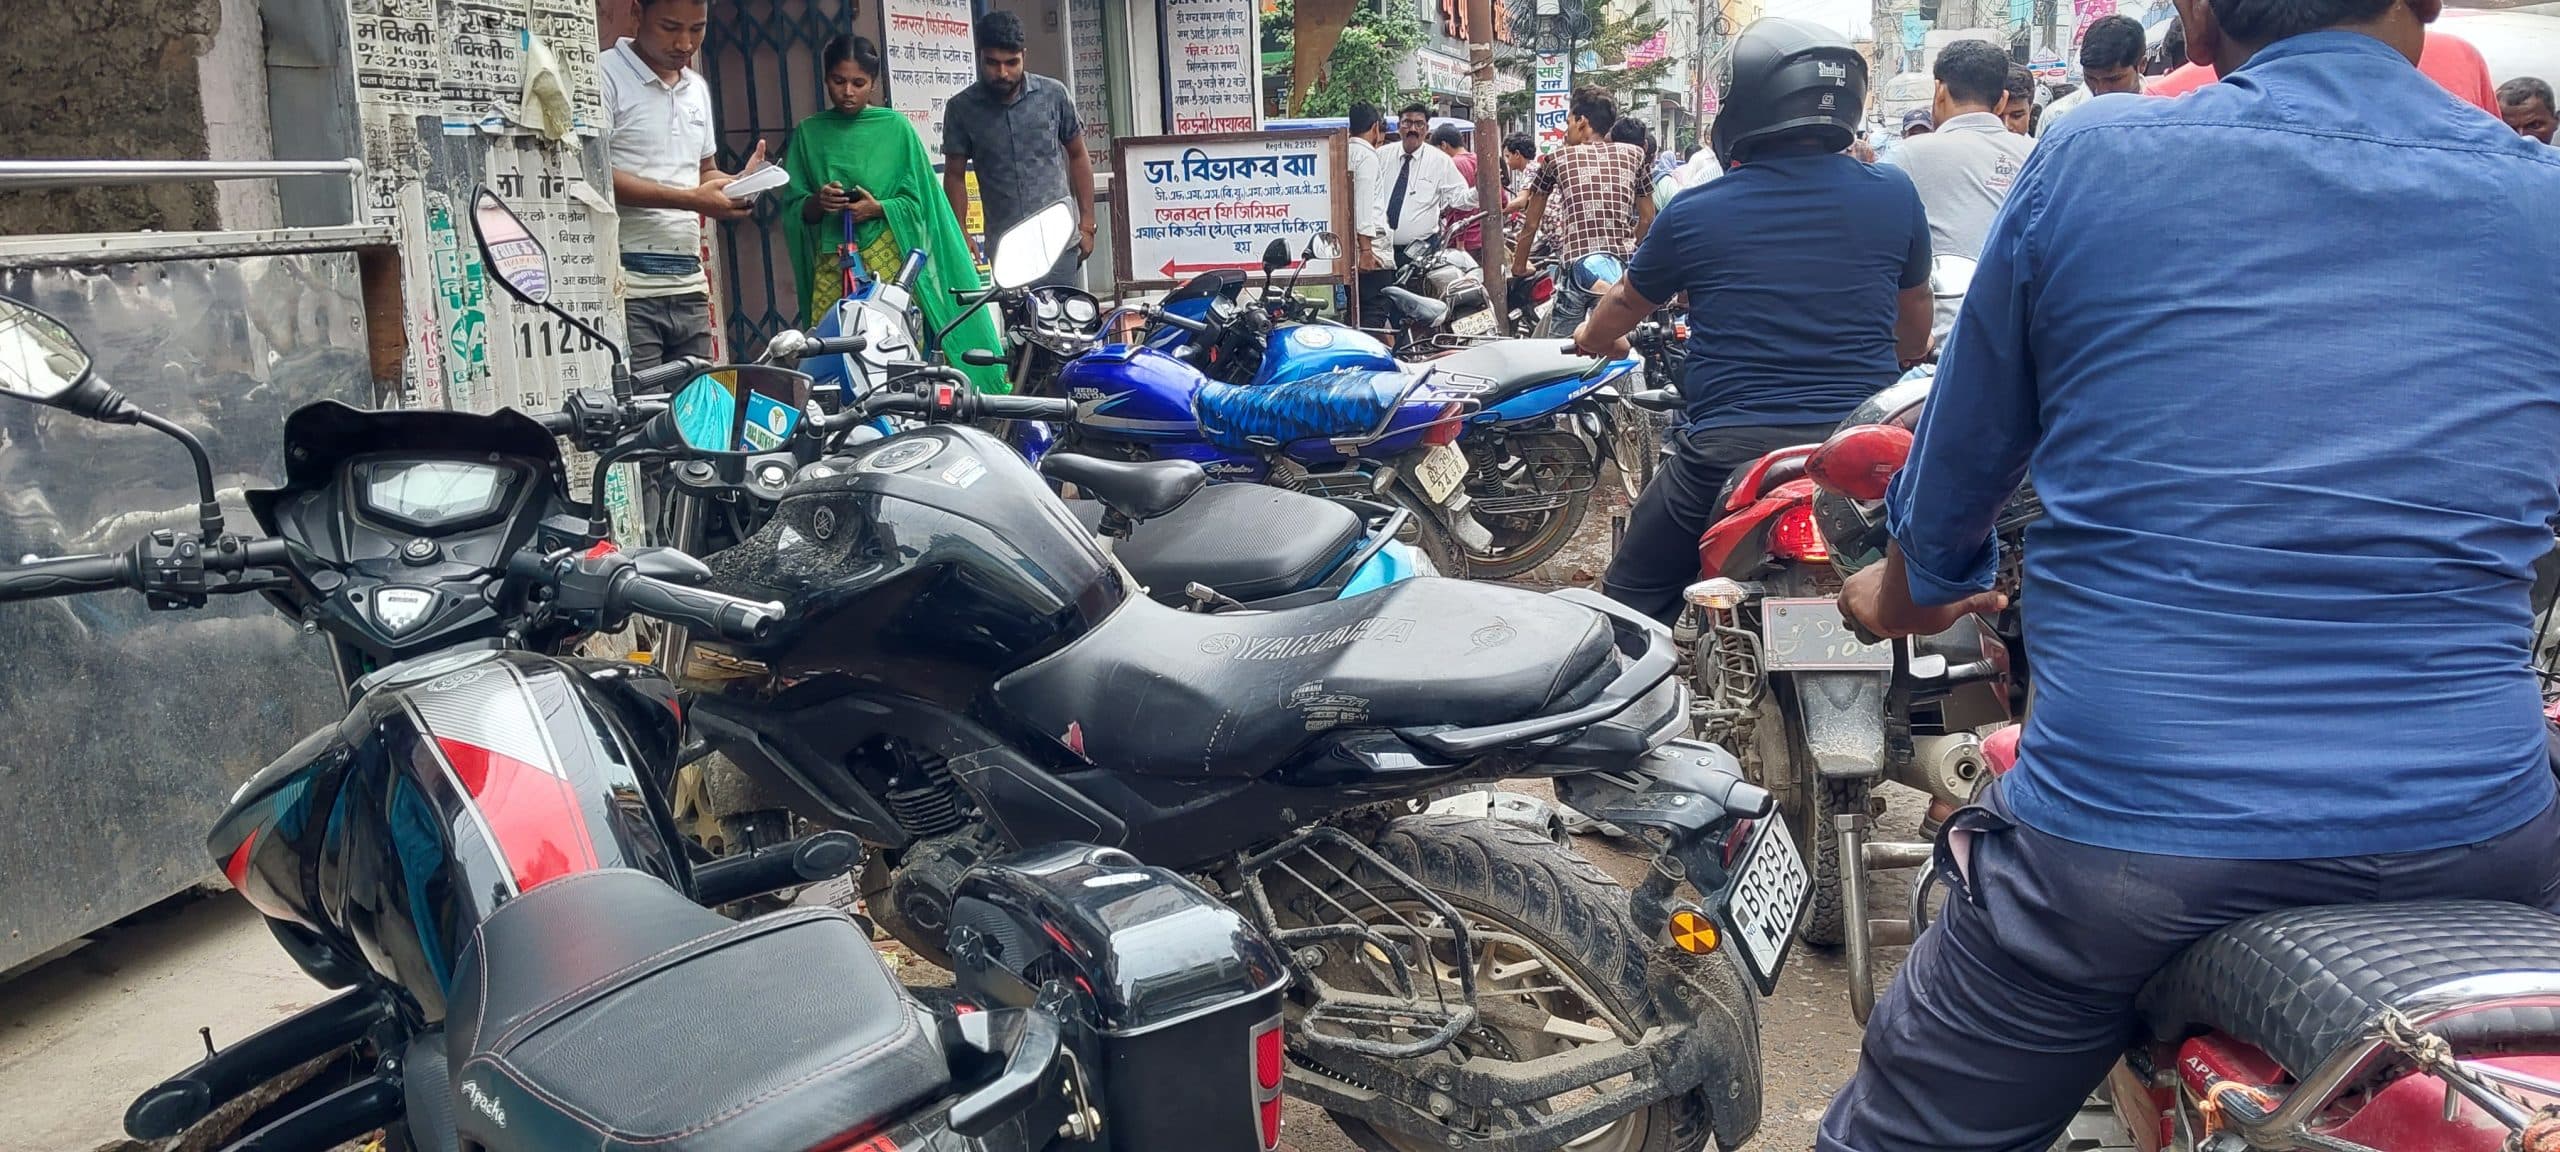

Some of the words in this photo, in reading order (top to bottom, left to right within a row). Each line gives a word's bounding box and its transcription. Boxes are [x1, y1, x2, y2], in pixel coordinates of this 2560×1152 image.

[1541, 80, 1563, 90] राम
[1539, 94, 1563, 109] न्यू
[1181, 148, 1279, 182] বিভাকর
[1134, 226, 1167, 240] এখানে
[1167, 221, 1207, 238] কিডনী
[1233, 240, 1253, 253] হয়
[1071, 392, 1107, 400] ONDA
[1740, 829, 1789, 919] BR39A
[461, 1080, 507, 1128] Apache
